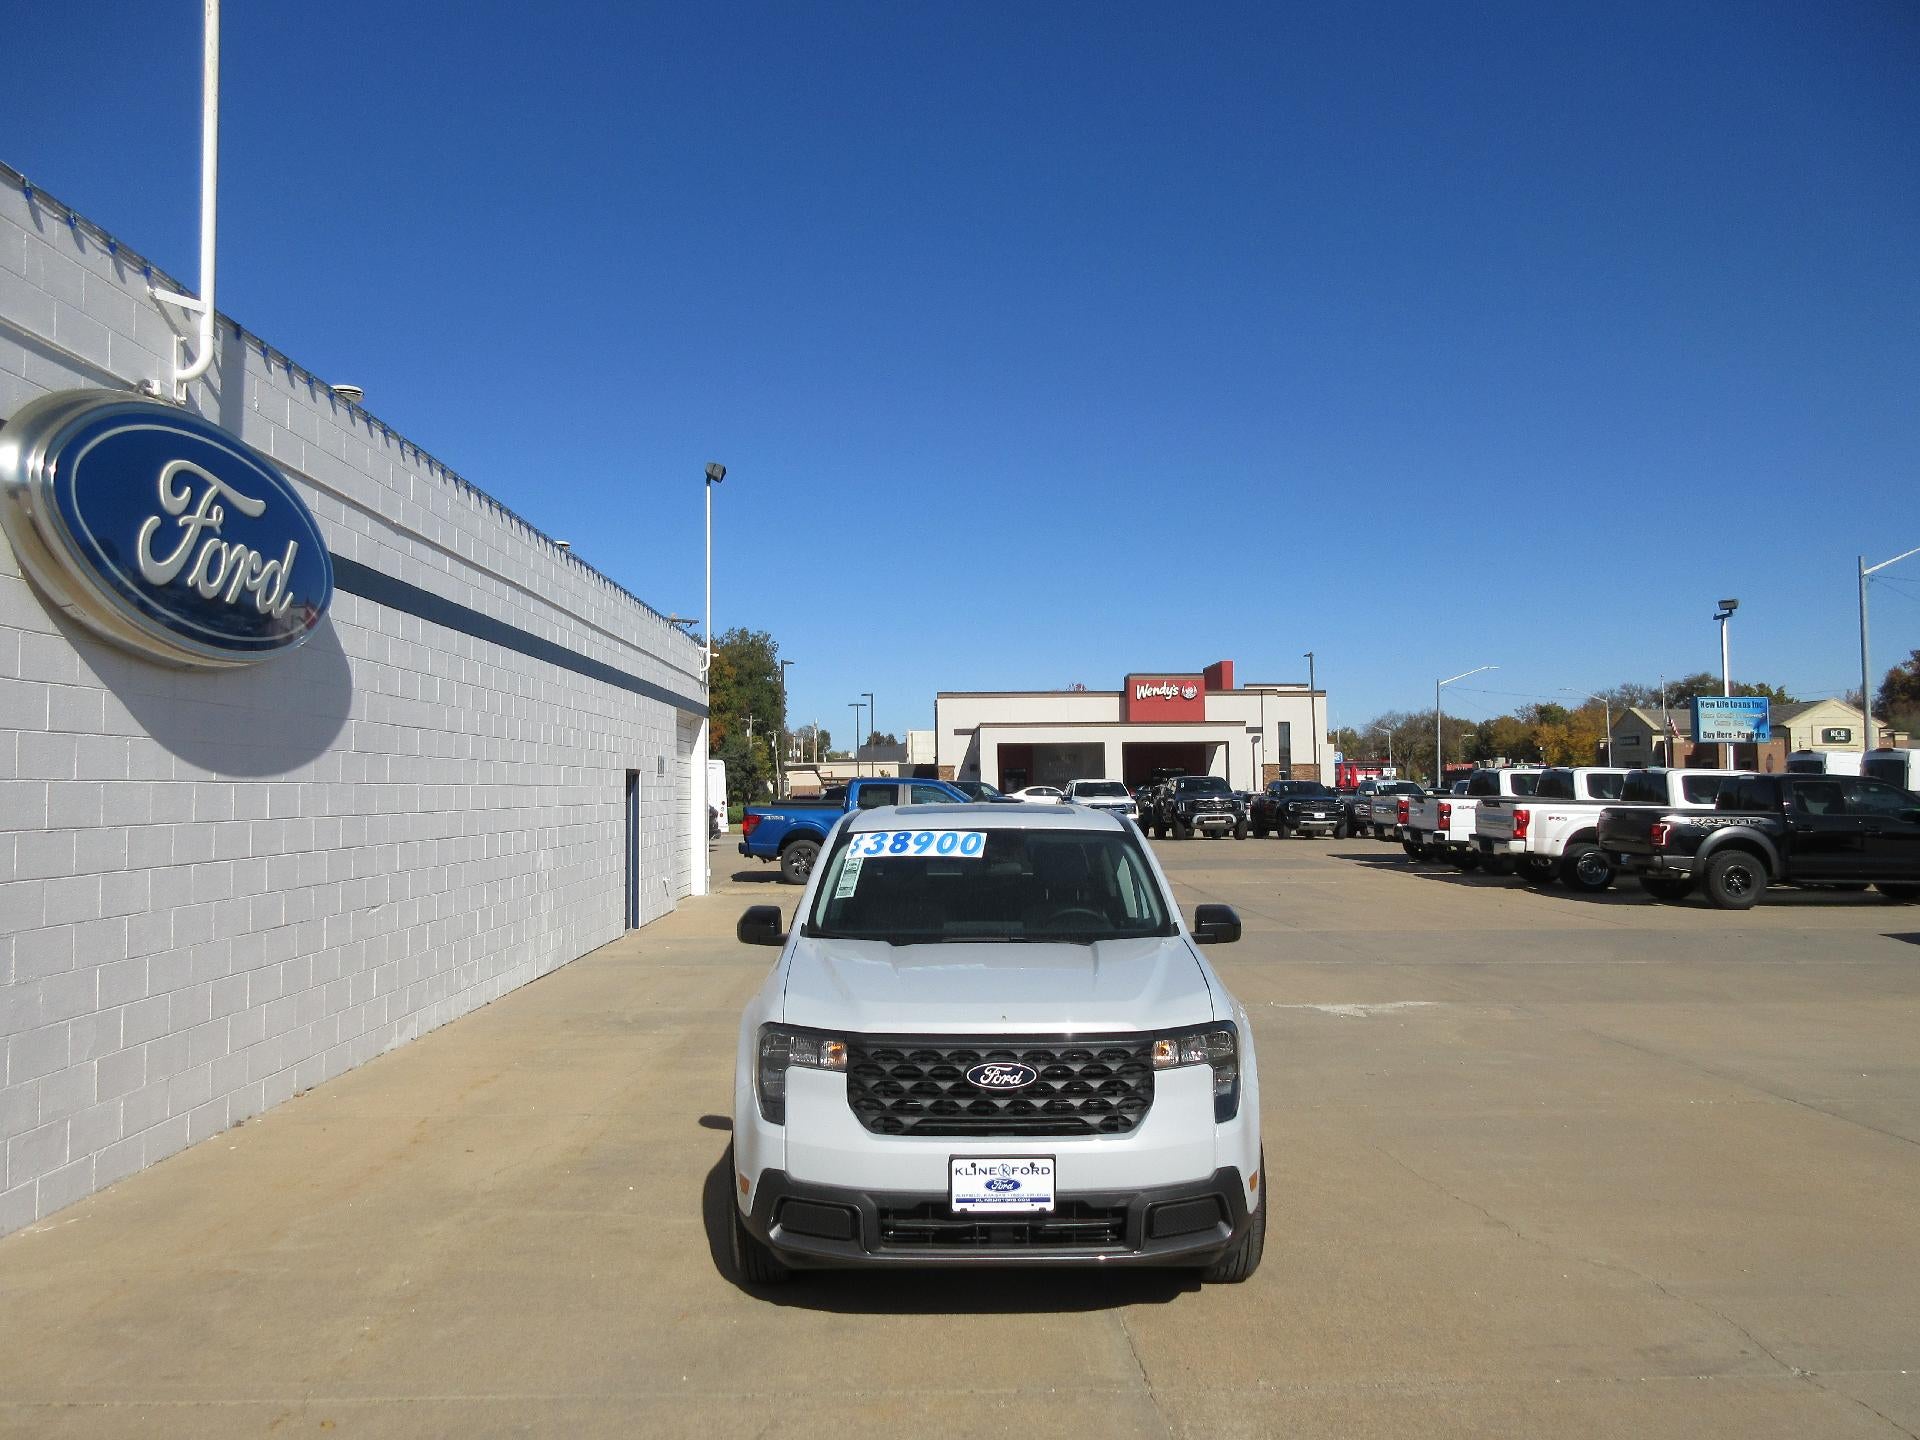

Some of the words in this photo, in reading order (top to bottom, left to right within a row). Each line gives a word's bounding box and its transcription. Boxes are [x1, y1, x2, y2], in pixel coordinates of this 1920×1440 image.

[137, 459, 300, 619] Ford
[1135, 681, 1180, 700] Wendy's
[1703, 731, 1715, 739] Buy
[1717, 731, 1732, 739] Here
[1689, 818, 1762, 829] RAPTOR
[849, 831, 984, 857] $38900
[979, 1065, 1024, 1085] Ford
[955, 1166, 997, 1176] KLINE
[1012, 1166, 1051, 1176] FORD
[991, 1180, 1014, 1190] Ford
